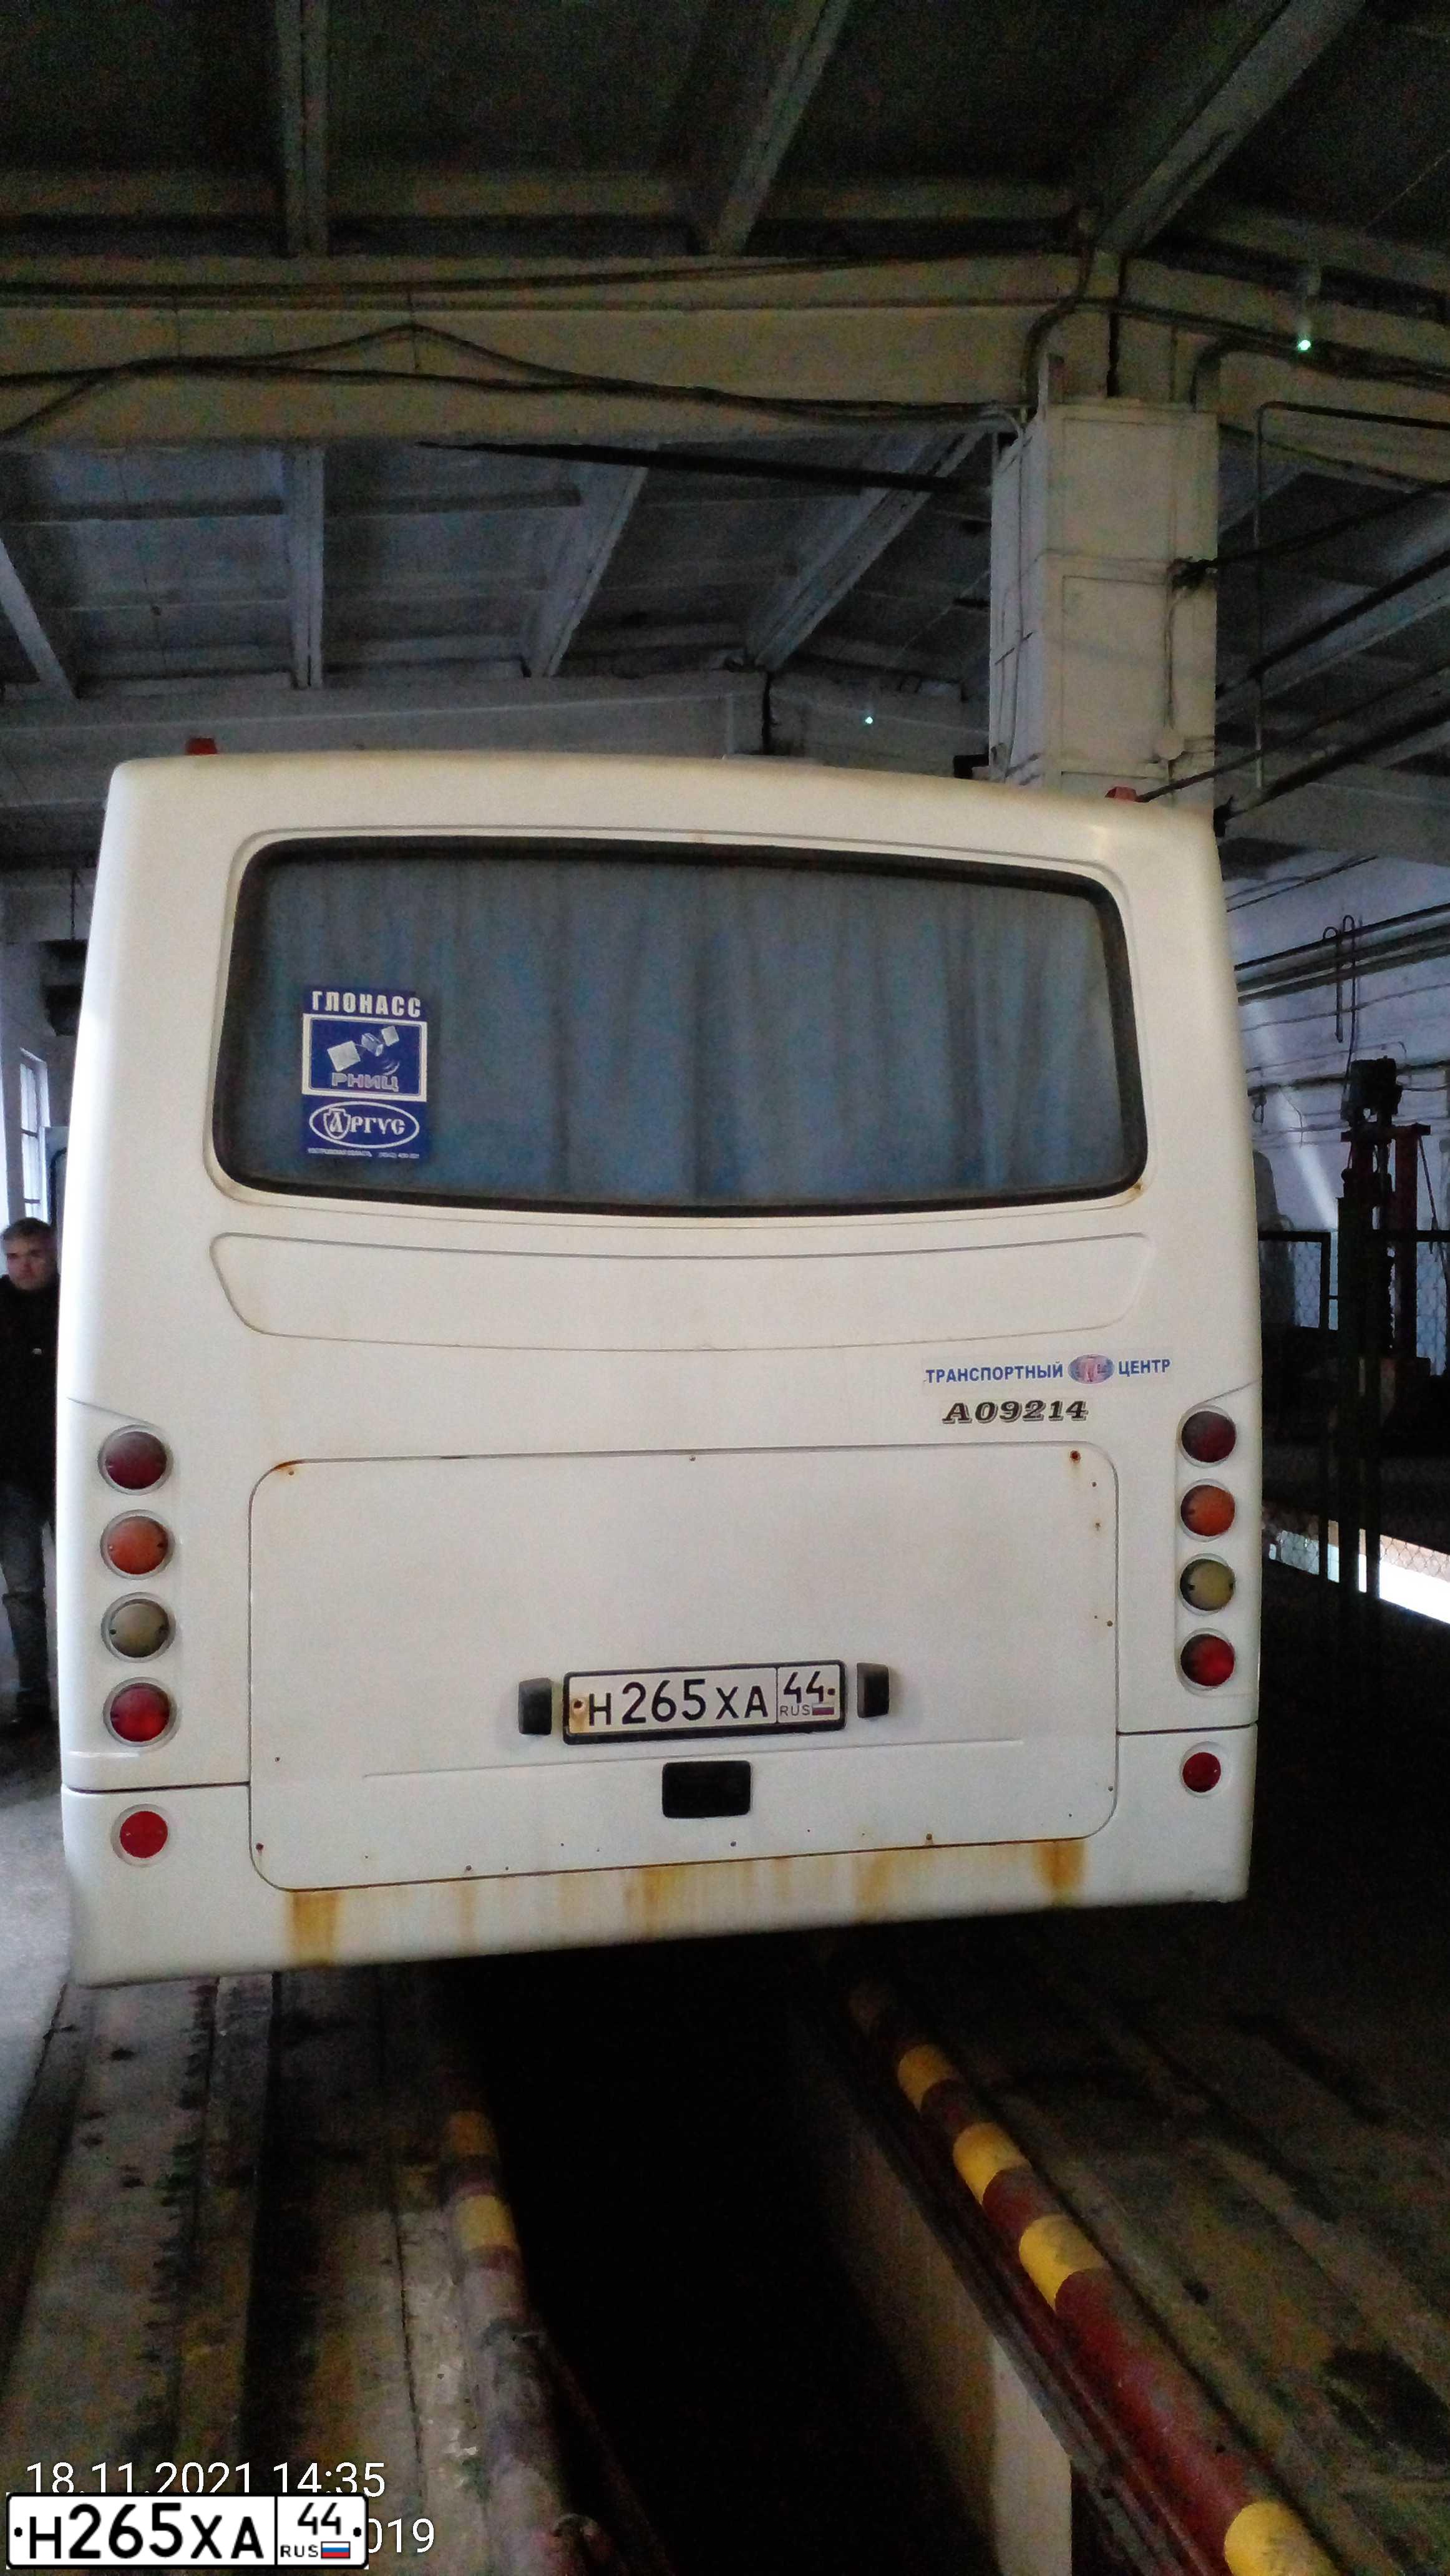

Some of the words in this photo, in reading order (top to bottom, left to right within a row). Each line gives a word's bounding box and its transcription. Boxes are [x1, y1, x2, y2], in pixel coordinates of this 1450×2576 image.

[312, 991, 421, 1018] ГЛОНАСС
[331, 1072, 399, 1092] РНИЦ
[926, 1361, 1063, 1383] ТРАНСПОРТНЫЙ
[1119, 1359, 1171, 1377] ЦЕНТР
[942, 1400, 1089, 1424] A09214
[783, 1671, 825, 1704] 44
[780, 1705, 811, 1717] RUS
